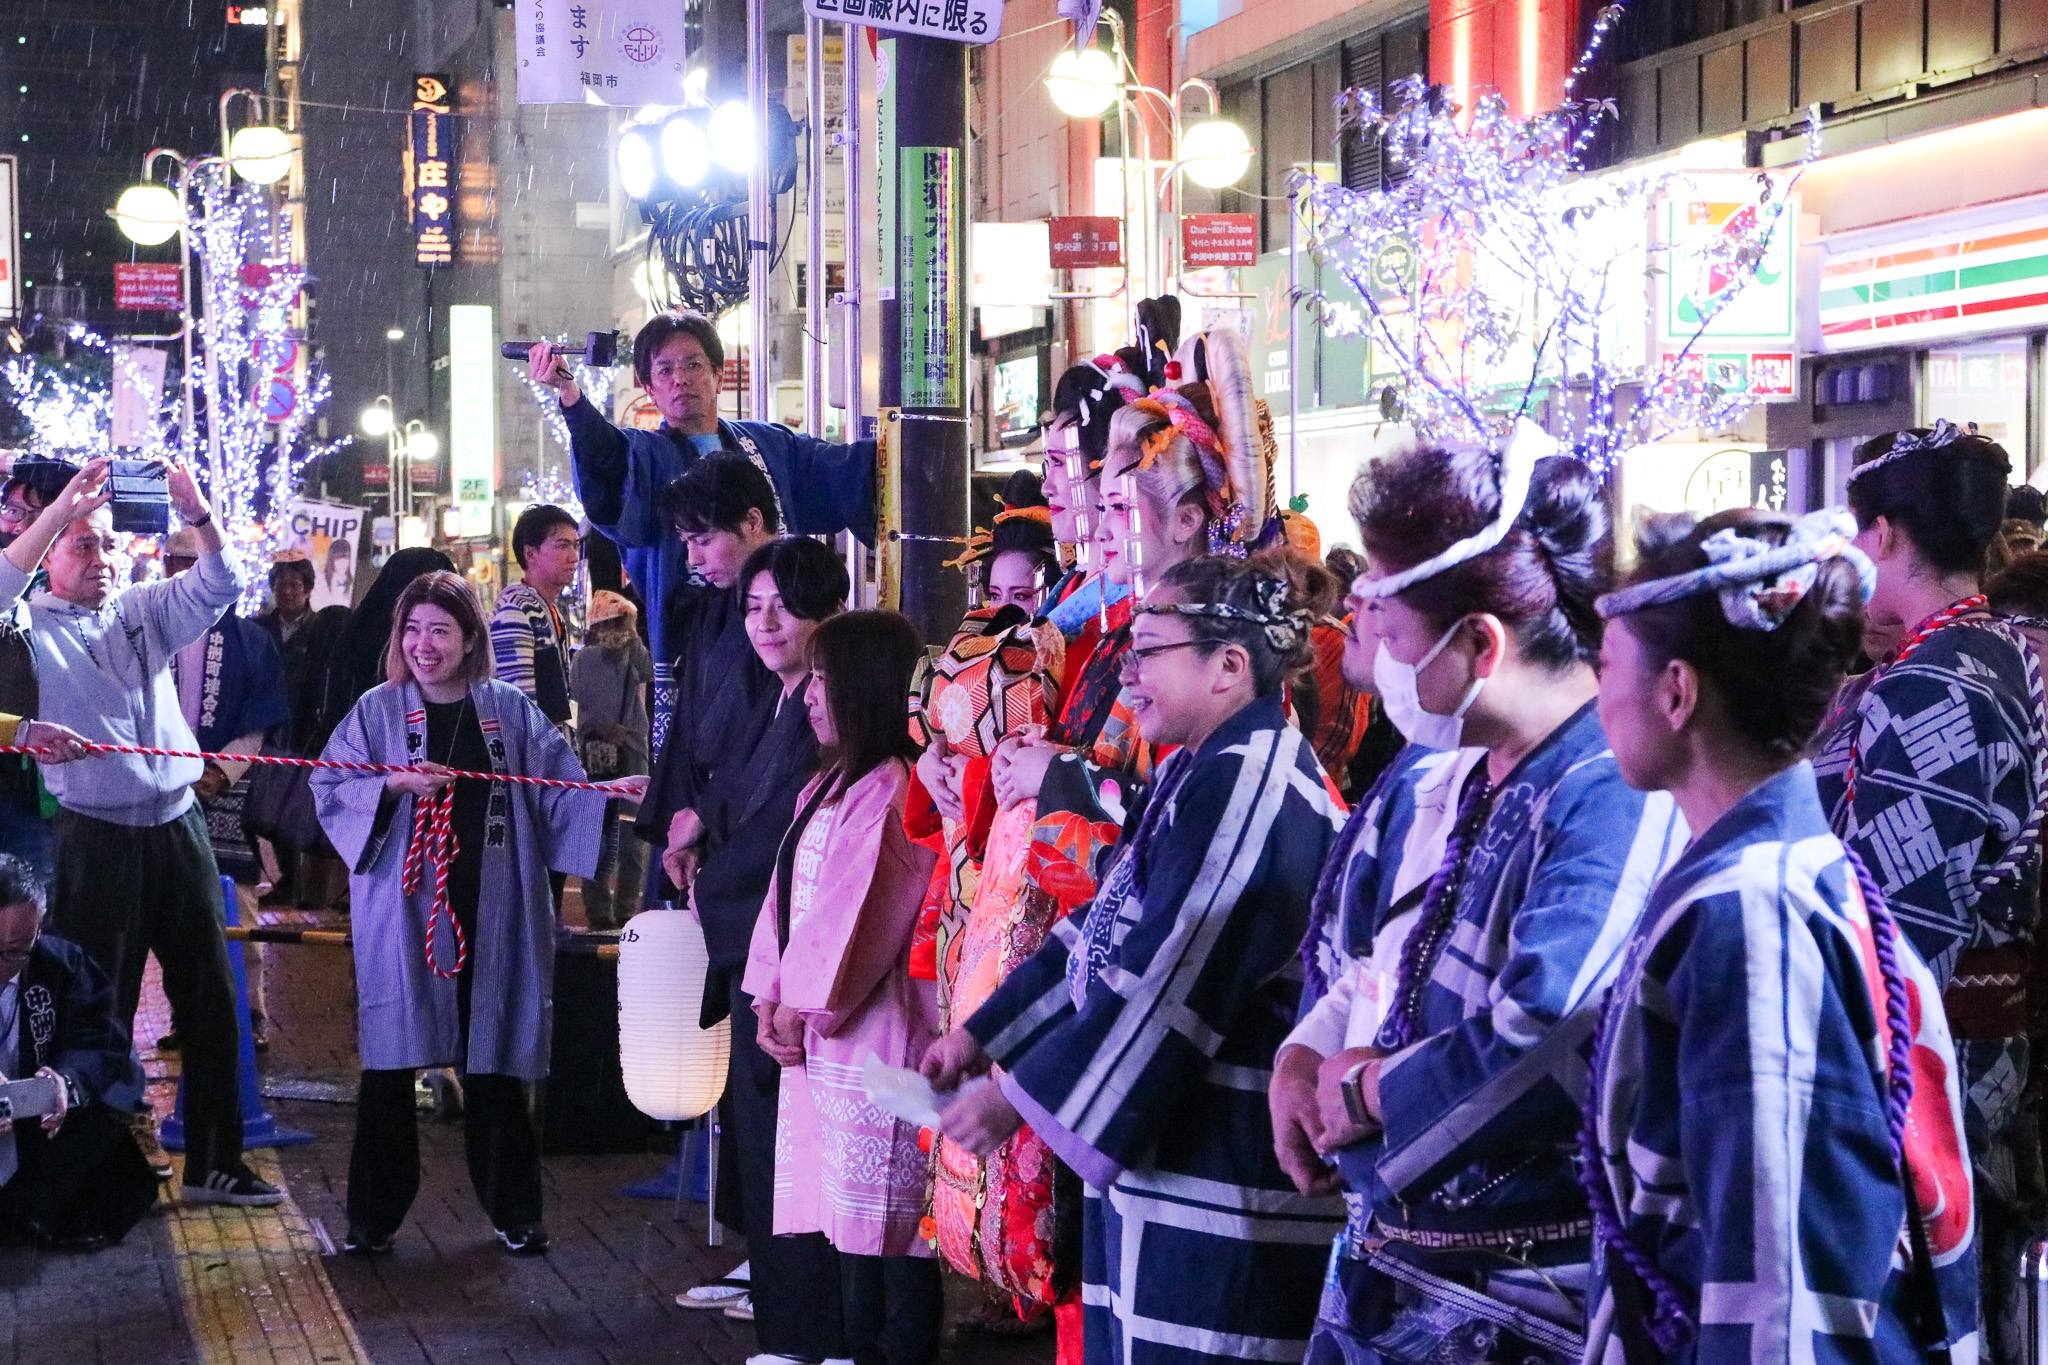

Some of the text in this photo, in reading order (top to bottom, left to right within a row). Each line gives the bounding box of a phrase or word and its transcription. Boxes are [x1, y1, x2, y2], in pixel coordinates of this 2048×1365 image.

[580, 71, 618, 89] 福岡市
[292, 514, 359, 538] CHIP
